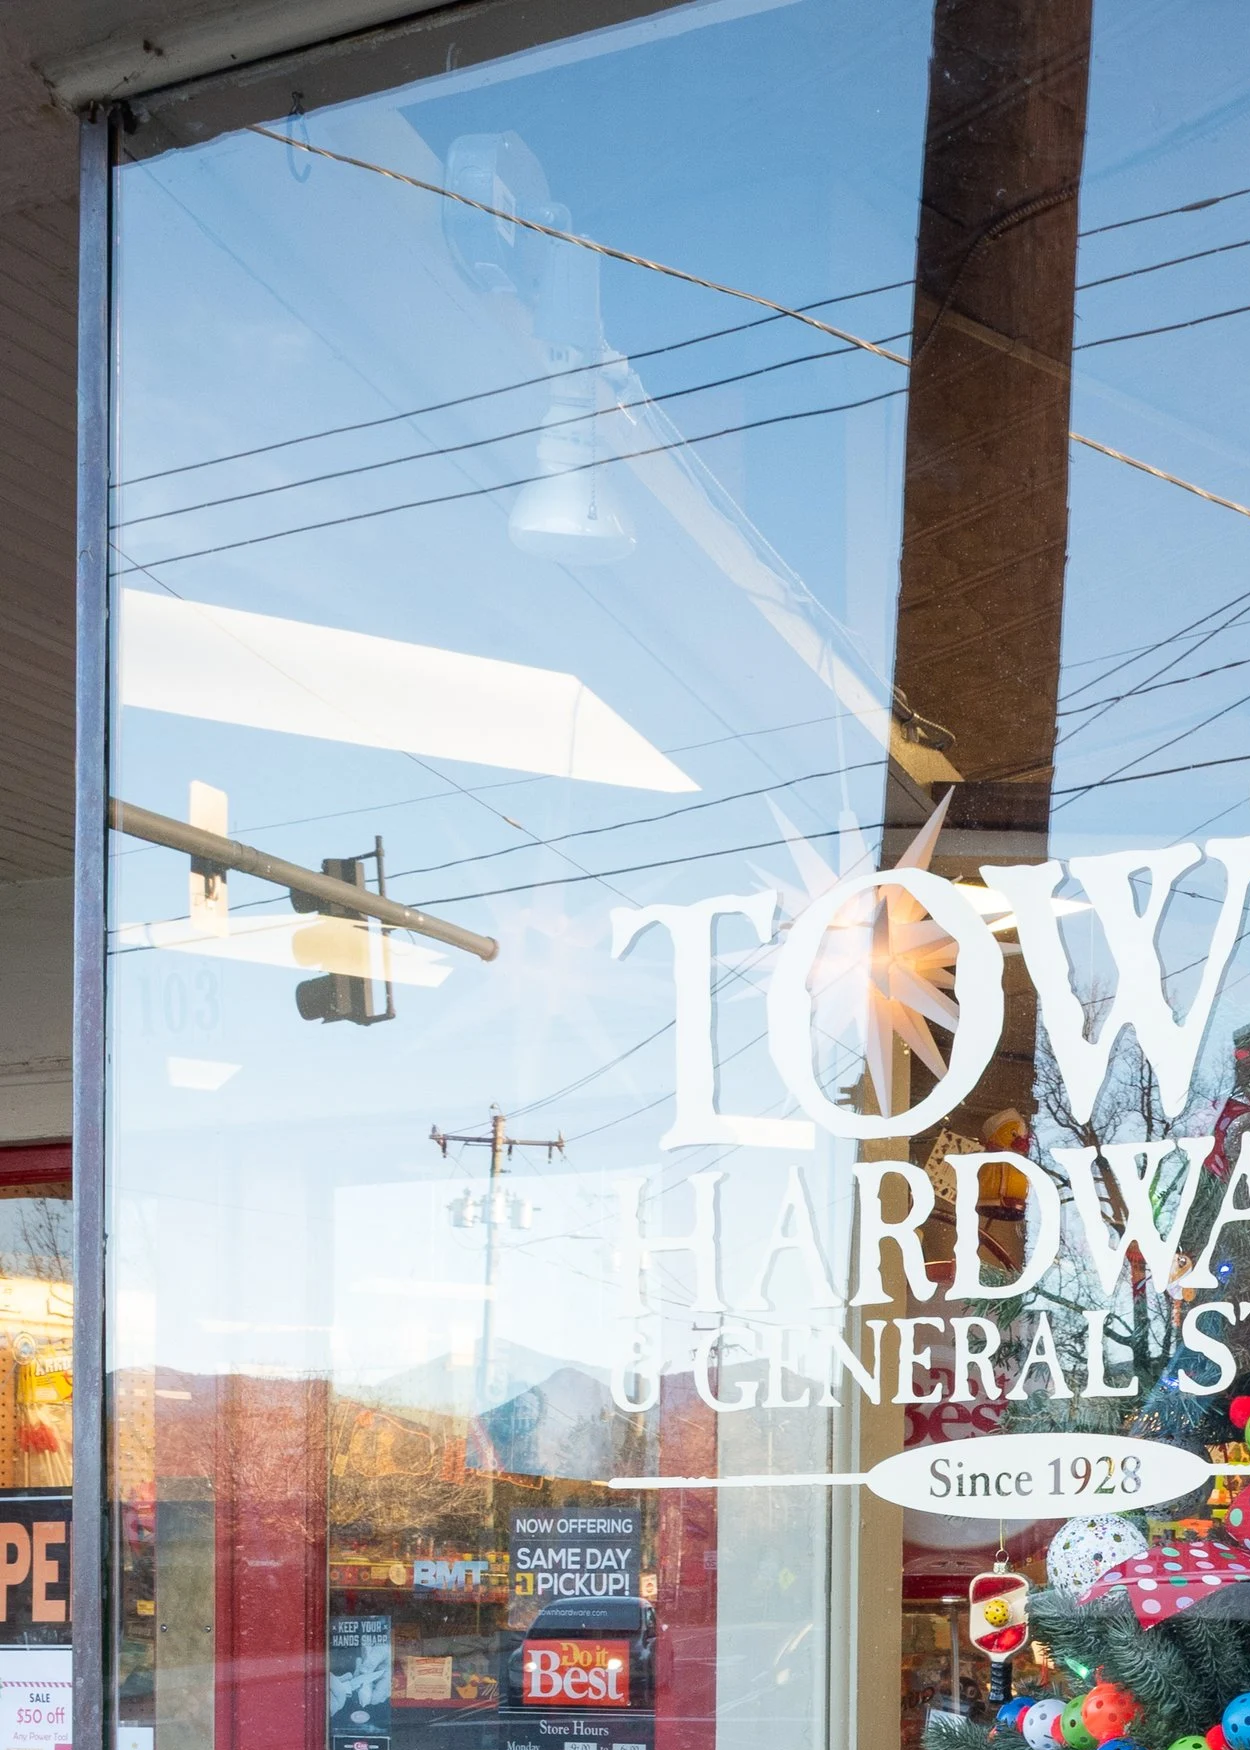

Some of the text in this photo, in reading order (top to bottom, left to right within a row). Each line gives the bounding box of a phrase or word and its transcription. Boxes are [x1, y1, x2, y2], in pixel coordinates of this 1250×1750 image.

[693, 1309, 1139, 1413] GENERAL
[929, 1455, 1143, 1498] Since 1928
[516, 1519, 633, 1534] NOW OFFERING
[516, 1548, 632, 1570] SAME DAY
[0, 1521, 73, 1622] PE
[413, 1560, 489, 1592] BMT
[537, 1573, 630, 1596] PICKUP!
[338, 1621, 381, 1633] KEEP YOUR
[332, 1635, 360, 1646] HANDS
[560, 1642, 592, 1667] Do
[527, 1650, 624, 1700] Best
[29, 1692, 51, 1703] SALE
[16, 1706, 65, 1725] $50 off
[29, 1732, 52, 1741] Power
[540, 1719, 609, 1736] Store Hours
